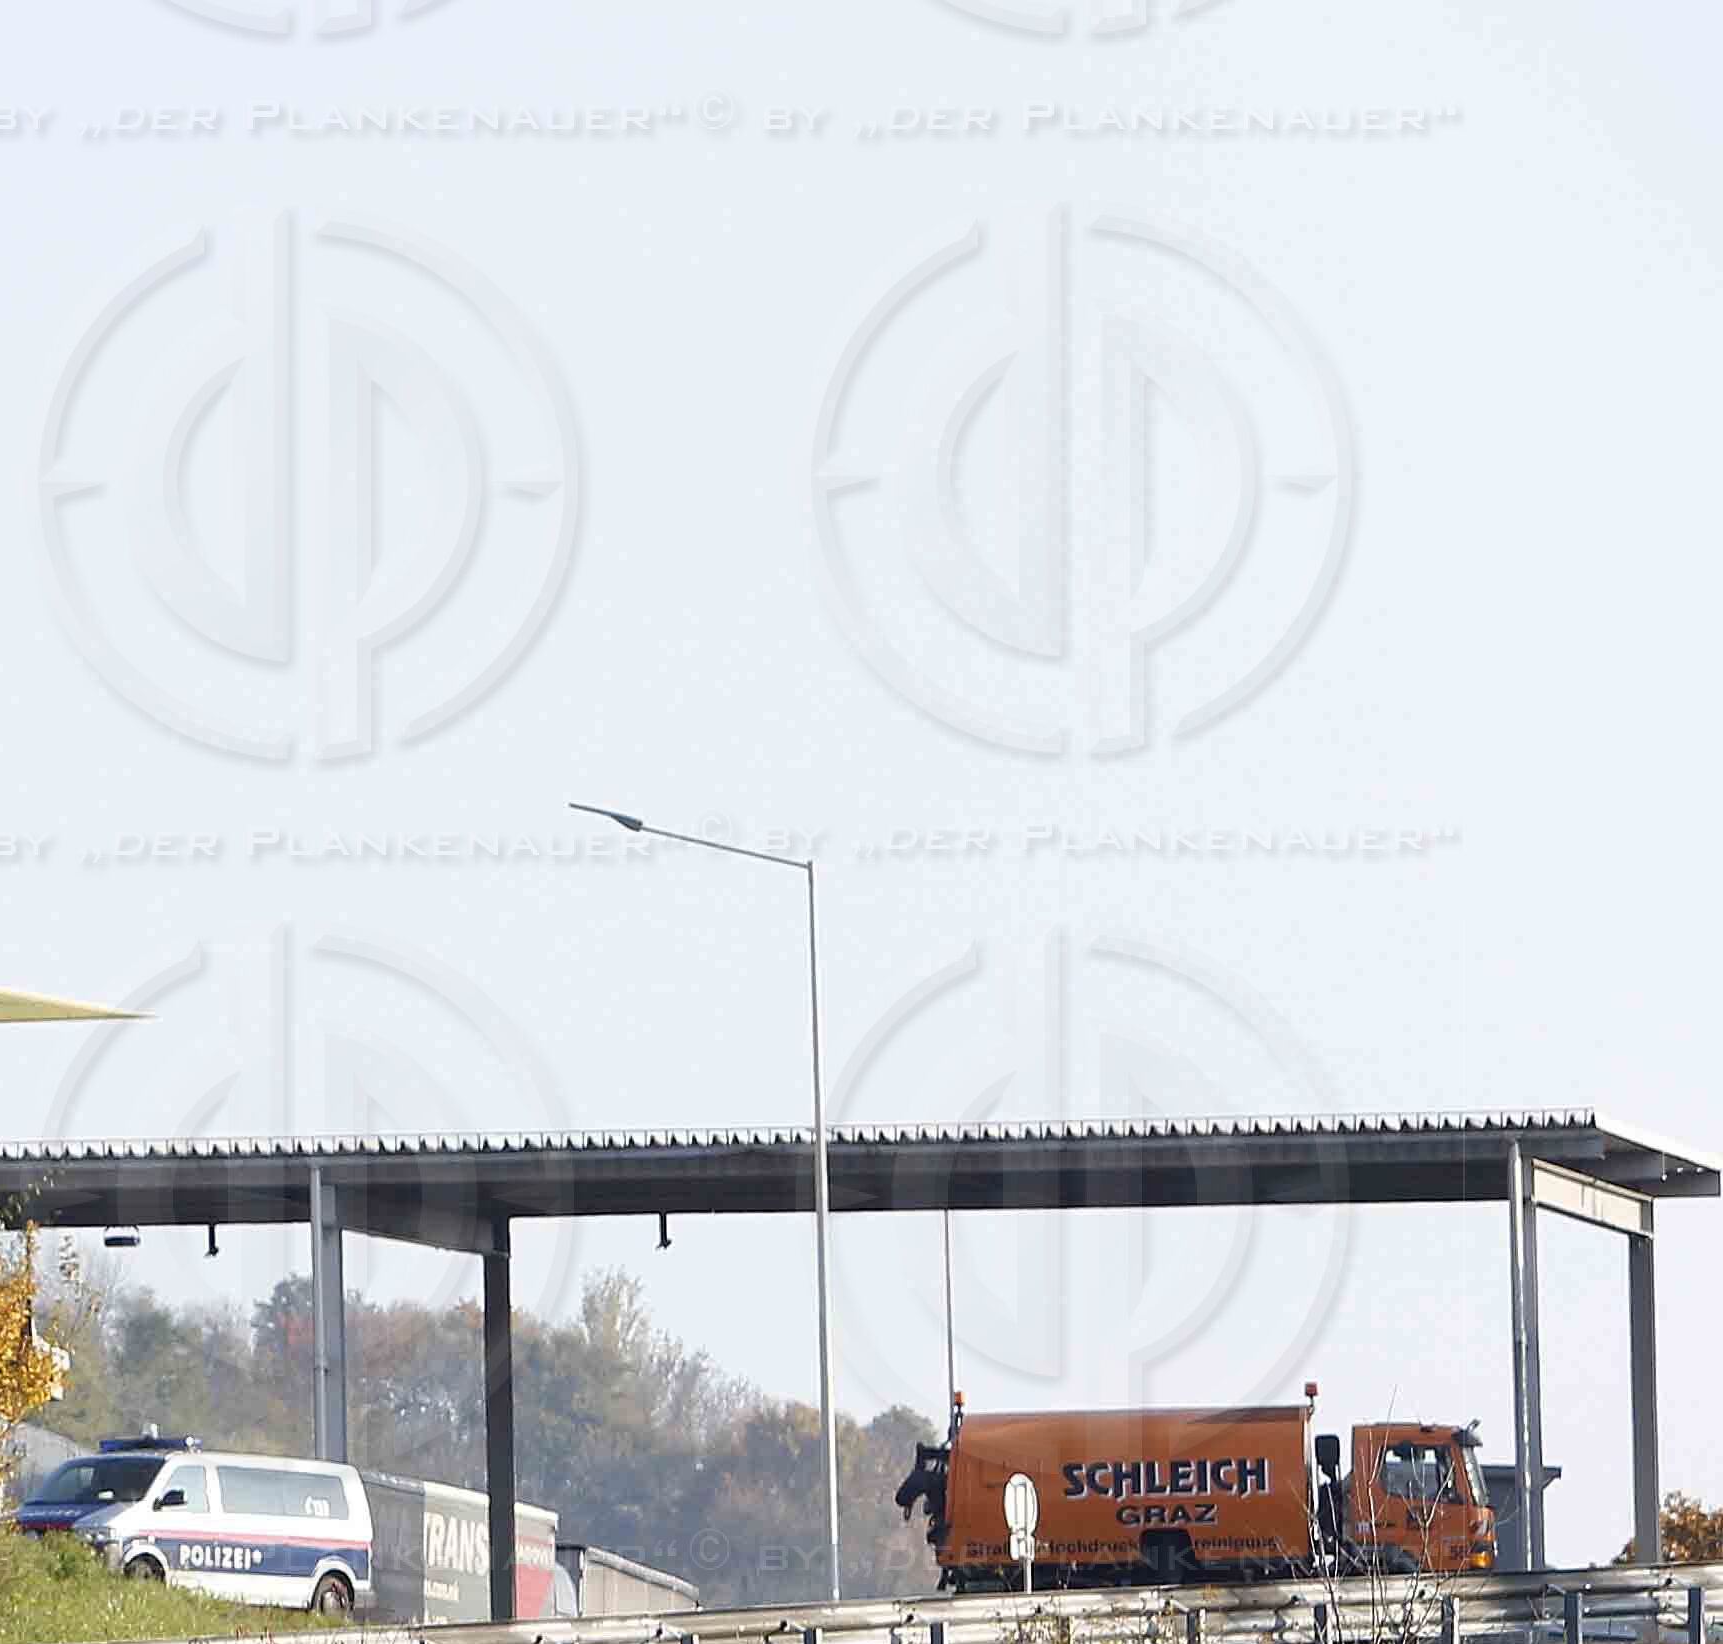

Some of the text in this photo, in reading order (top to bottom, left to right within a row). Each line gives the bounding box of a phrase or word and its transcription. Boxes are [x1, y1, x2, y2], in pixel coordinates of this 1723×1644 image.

[1062, 1457, 1270, 1500] SCHLEICH
[1116, 1504, 1218, 1527] GRAZ
[179, 1543, 252, 1570] POLIZEI
